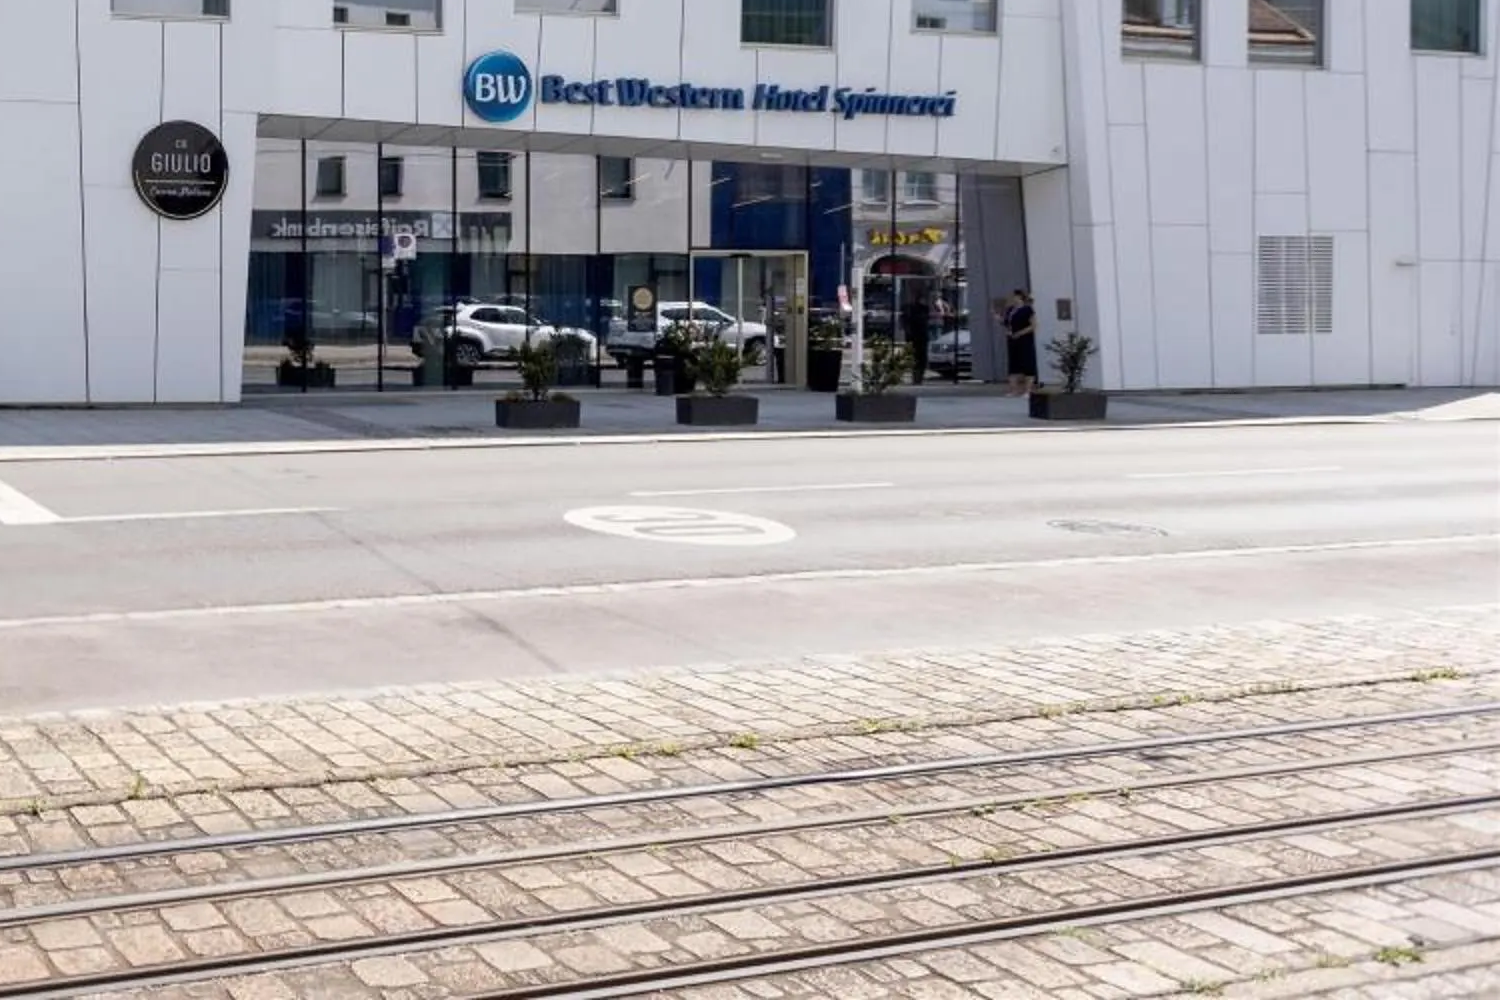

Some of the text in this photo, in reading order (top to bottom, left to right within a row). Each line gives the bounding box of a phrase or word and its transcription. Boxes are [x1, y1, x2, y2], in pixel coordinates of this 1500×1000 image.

[475, 73, 526, 104] BW
[541, 75, 958, 120] Best Western Hotel Spinnerei
[151, 152, 211, 174] GIULIO
[591, 511, 766, 537] 30
